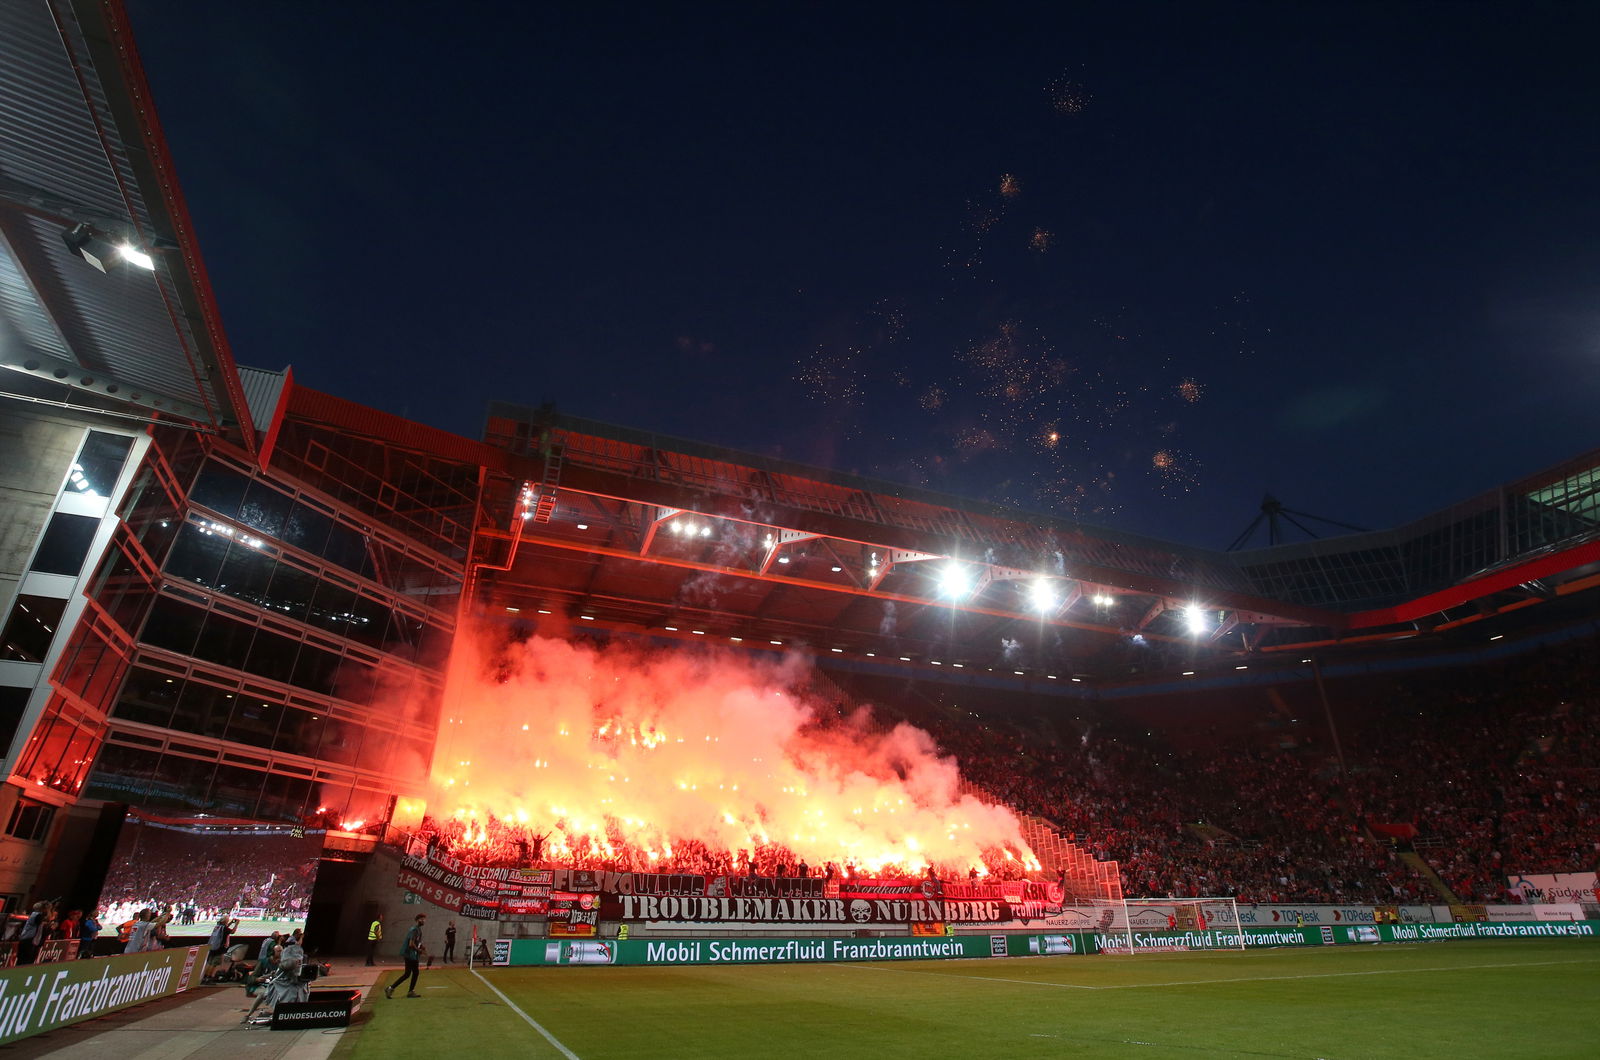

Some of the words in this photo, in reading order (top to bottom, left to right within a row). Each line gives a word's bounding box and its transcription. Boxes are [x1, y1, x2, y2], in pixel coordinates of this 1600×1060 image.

[554, 869, 632, 895] FLSKO
[434, 889, 444, 901] S
[1549, 887, 1596, 898] Südwes
[619, 895, 847, 921] TROUBLEMAKER
[875, 899, 1000, 921] NÜRNBERG
[1341, 909, 1374, 921] TOPdes
[1094, 933, 1130, 951] Mobil
[1134, 930, 1212, 948] Schmerzfluid
[1216, 930, 1305, 947] Franzbranntwein
[1392, 924, 1419, 940] Mobil
[1420, 922, 1475, 939] Schmerzfluid
[1476, 922, 1593, 938] Franzbranntwein
[647, 942, 701, 962] Mobil
[709, 941, 825, 961] Schmerzfluid
[833, 939, 964, 959] Franzbranntwein
[38, 956, 172, 1028] Franzbranntwein
[278, 1010, 347, 1021] BUNDESLIGA.COM
